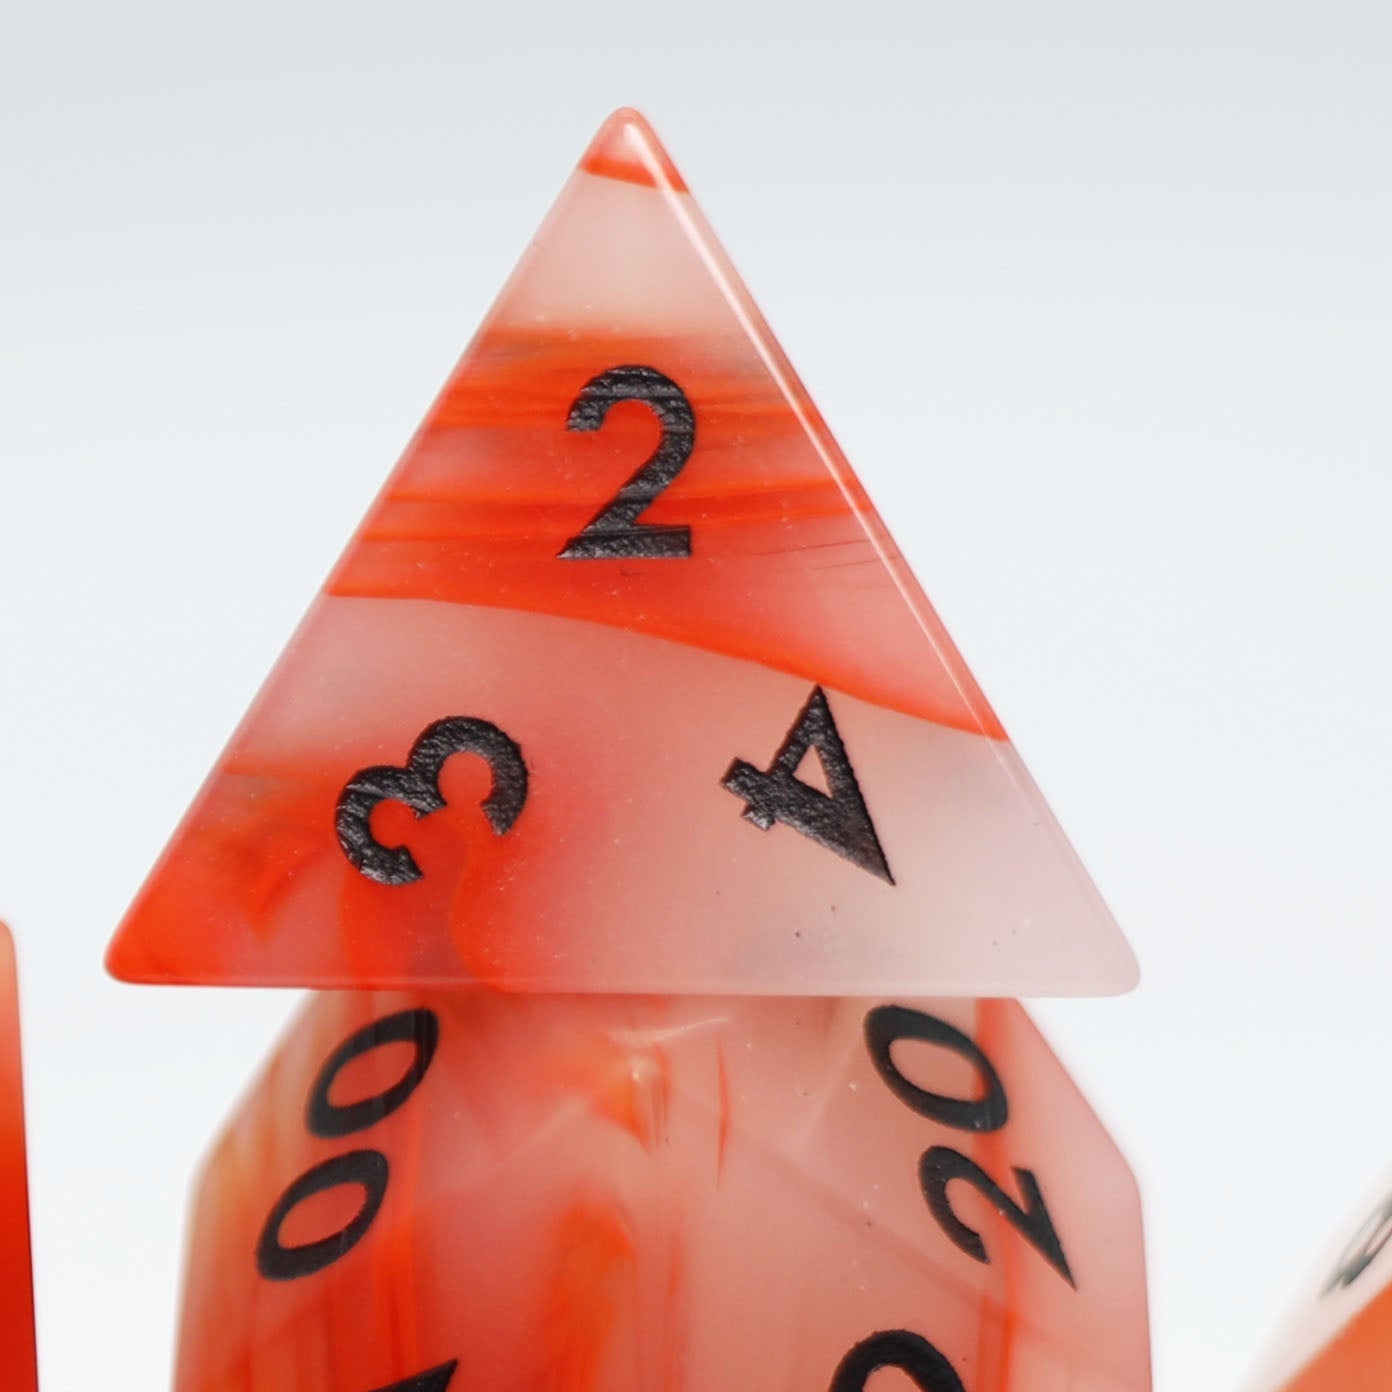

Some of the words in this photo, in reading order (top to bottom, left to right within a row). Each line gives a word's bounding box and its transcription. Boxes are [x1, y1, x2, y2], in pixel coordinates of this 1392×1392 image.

[556, 365, 697, 560] 2
[335, 715, 530, 886] 3
[722, 685, 897, 886] 4
[256, 1005, 440, 1281] 00
[865, 1004, 1078, 1291] 20
